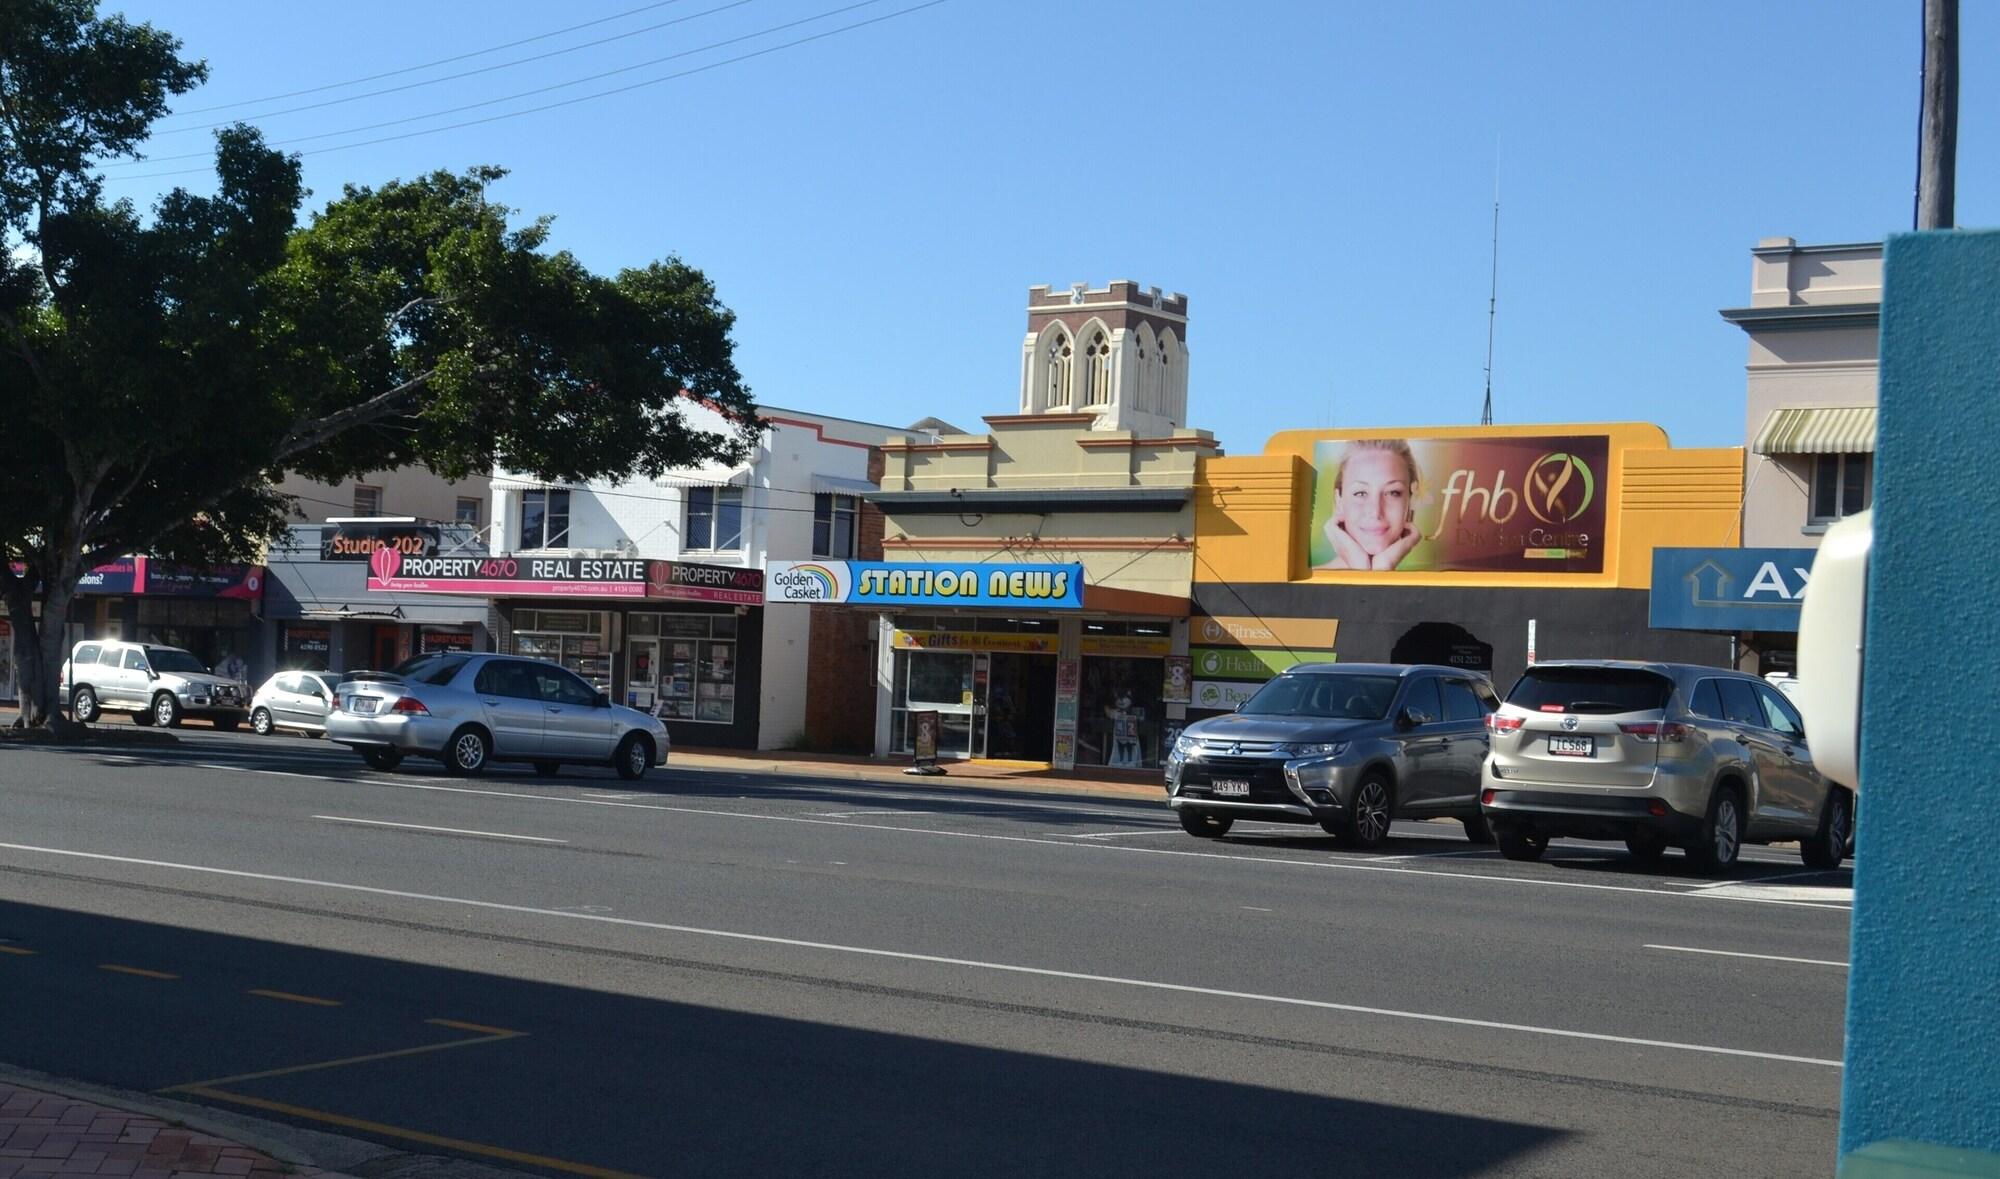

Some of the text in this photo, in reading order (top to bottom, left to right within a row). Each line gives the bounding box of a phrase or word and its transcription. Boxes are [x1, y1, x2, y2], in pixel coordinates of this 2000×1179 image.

[1425, 469, 1518, 540] fhb
[334, 536, 423, 555] Studio 202
[532, 560, 575, 578] REAL
[580, 560, 644, 579] ESTATE
[774, 572, 814, 586] Golden
[859, 569, 1069, 599] STATION NEWS
[713, 592, 733, 601] REAL
[735, 593, 761, 603] ESTATE
[784, 586, 821, 599] Casket
[1227, 623, 1273, 639] Fitness
[928, 634, 959, 648] Gifts
[1226, 657, 1265, 672] Health
